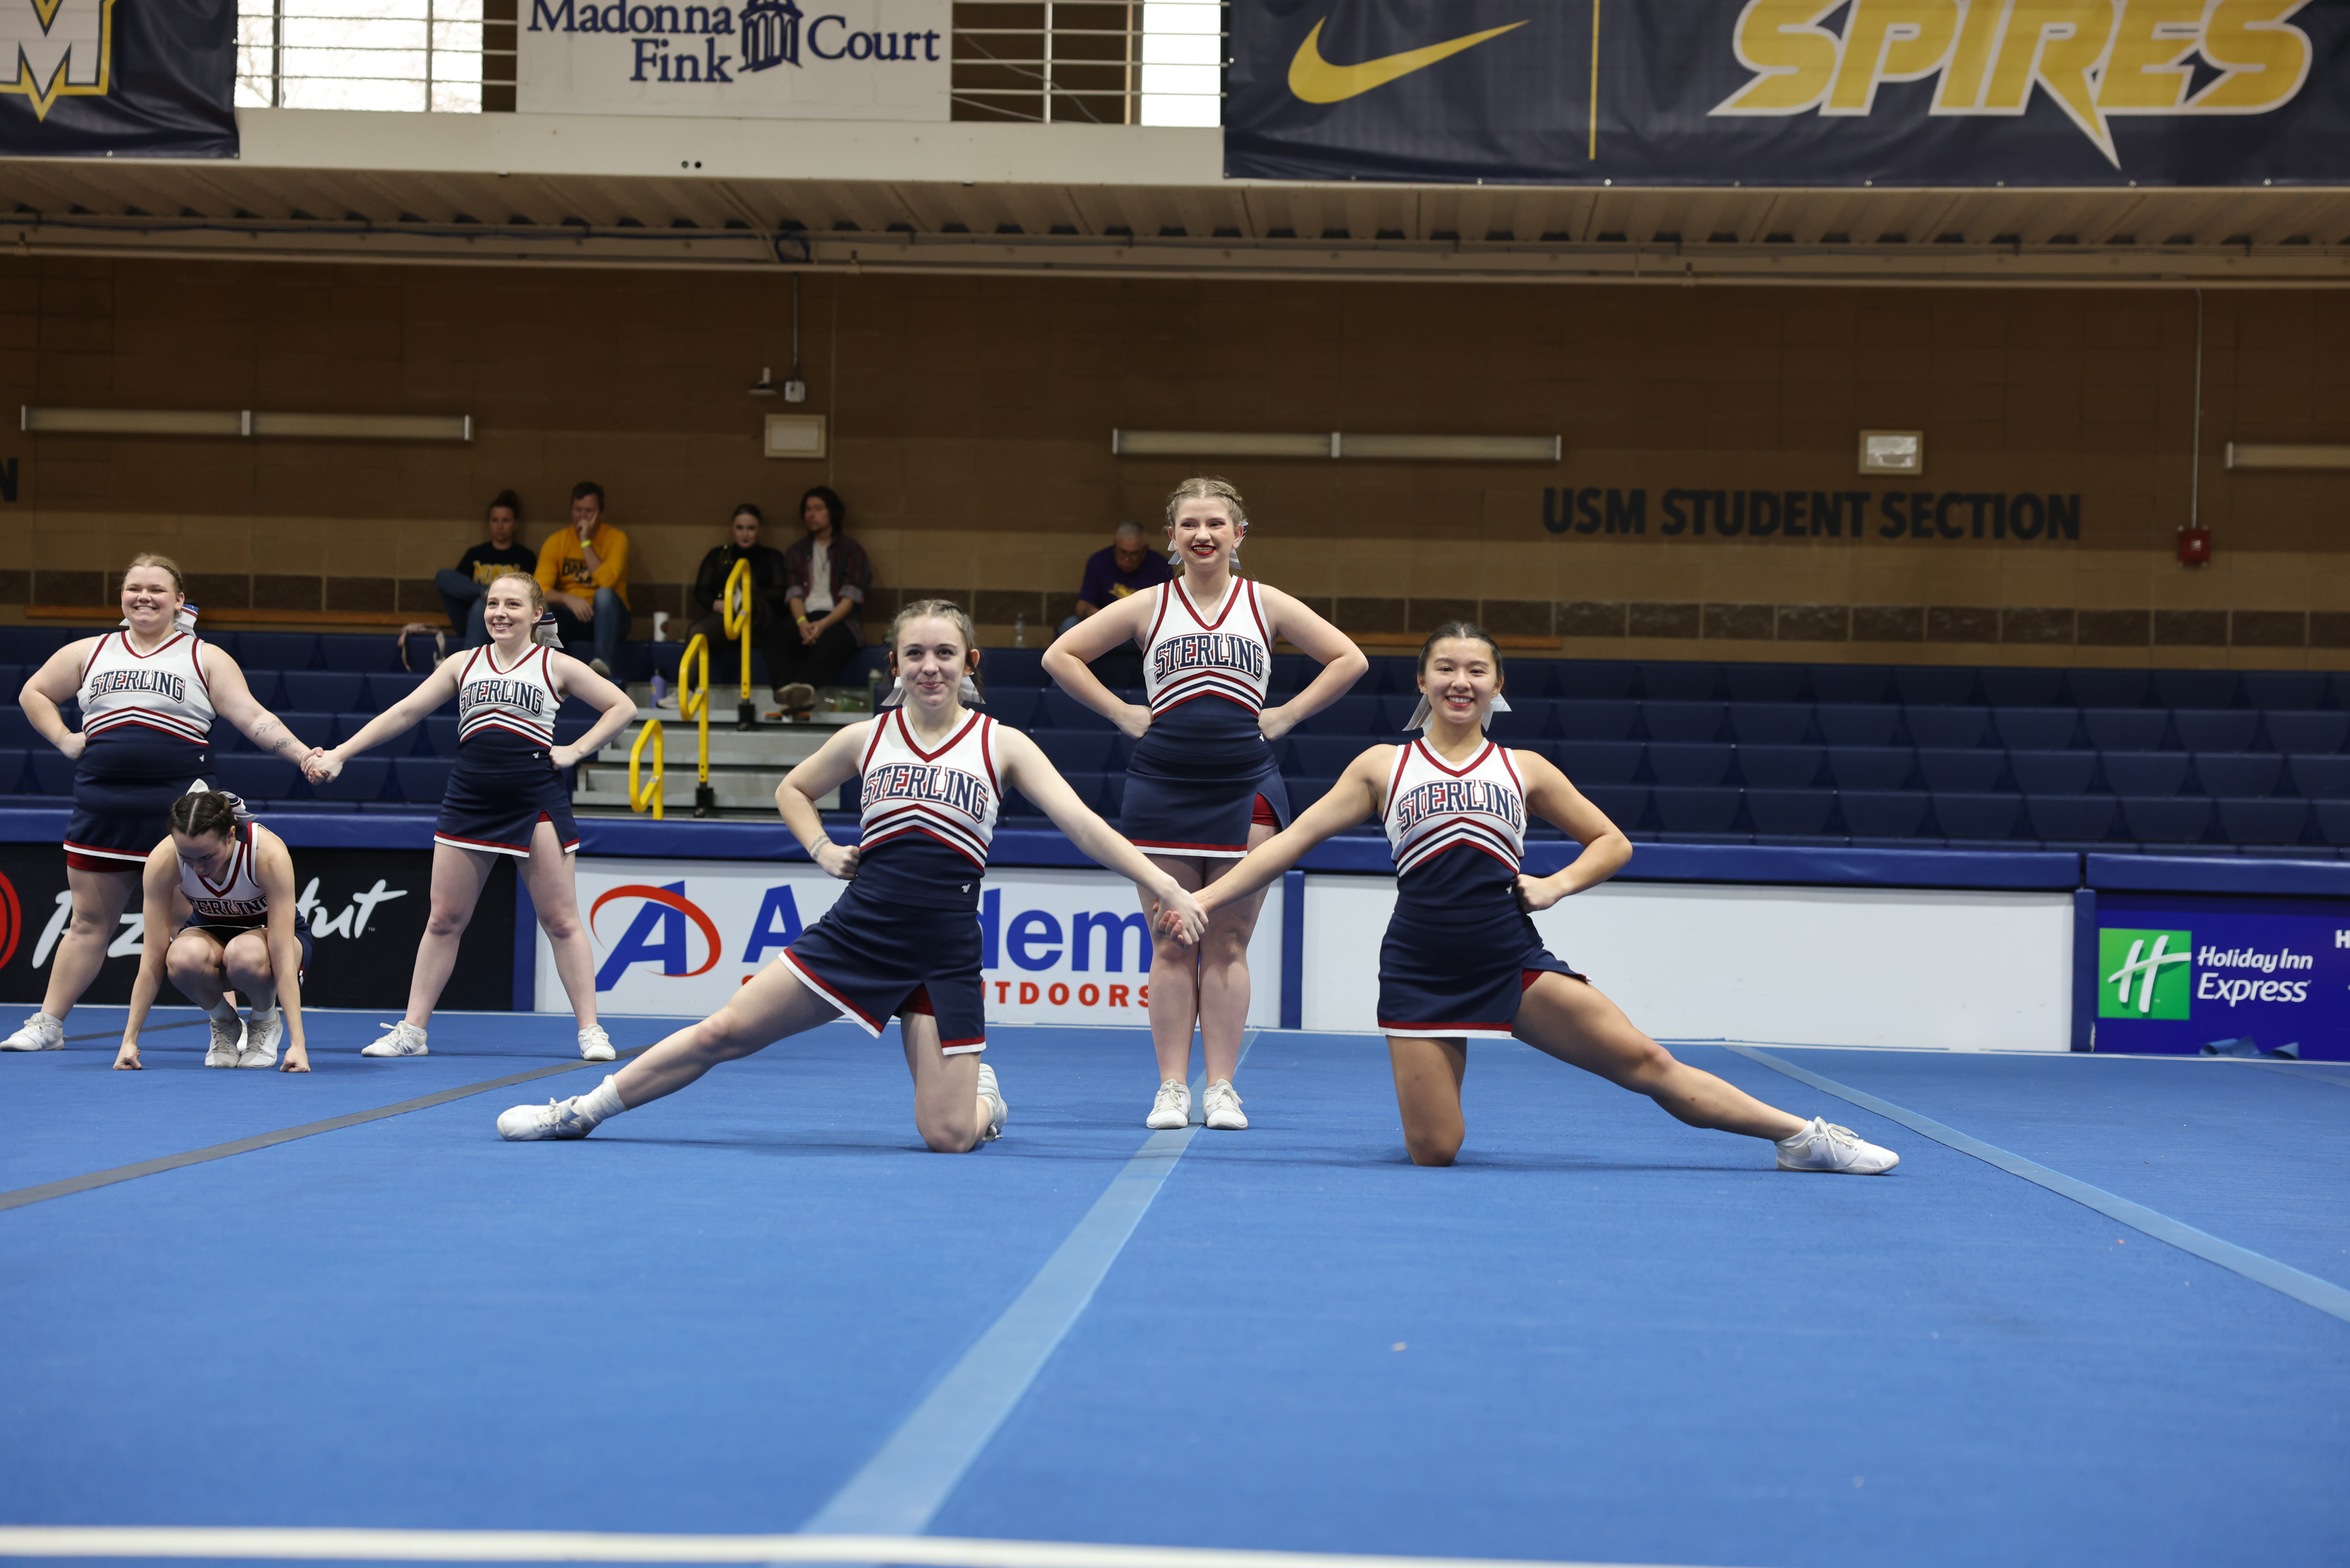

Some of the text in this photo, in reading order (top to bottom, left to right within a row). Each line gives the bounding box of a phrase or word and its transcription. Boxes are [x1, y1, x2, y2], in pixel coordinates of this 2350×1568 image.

[527, 0, 735, 34] Madonna
[807, 15, 941, 61] Court
[630, 37, 734, 83] Fink
[1706, 0, 2313, 170] SPIRES
[1543, 487, 2081, 540] USM STUDENT SECTION
[1154, 633, 1263, 684] STERLING
[88, 669, 186, 704] STERLING
[460, 678, 544, 717] STERLING
[862, 763, 989, 824] STERLING
[1396, 780, 1521, 839] STERLING
[2197, 945, 2314, 973] Holiday Inn
[2197, 972, 2308, 1007] Express
